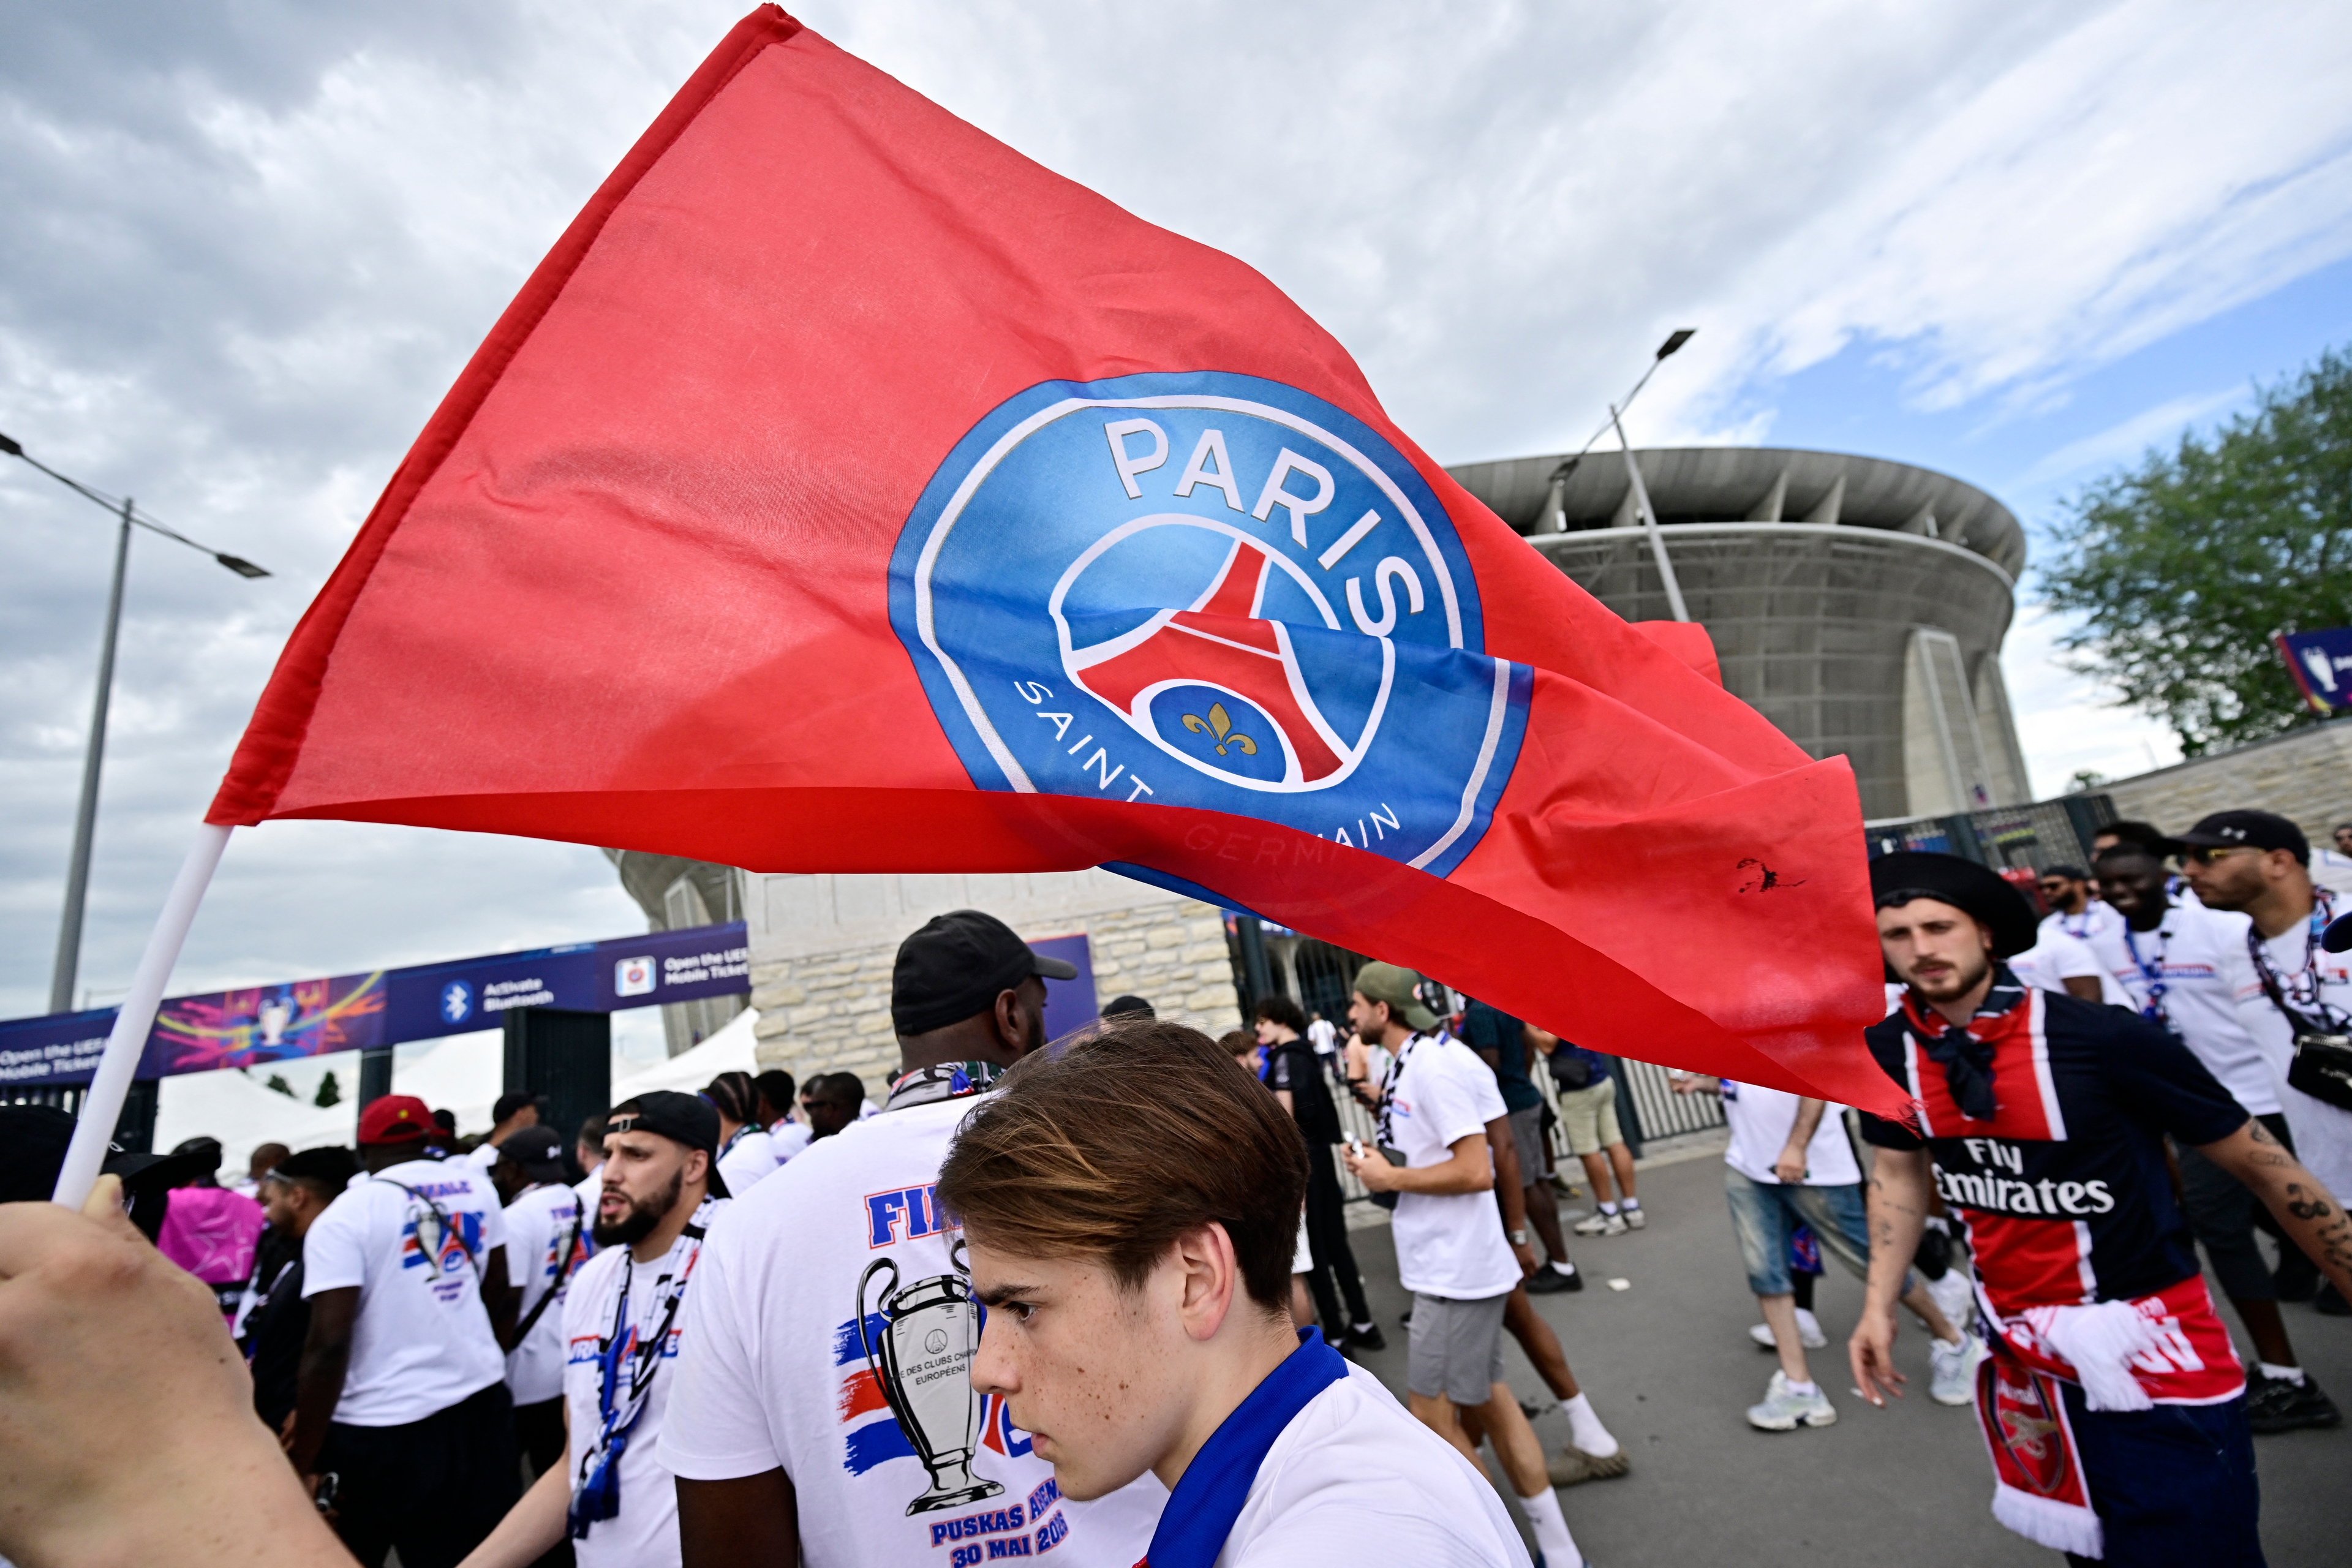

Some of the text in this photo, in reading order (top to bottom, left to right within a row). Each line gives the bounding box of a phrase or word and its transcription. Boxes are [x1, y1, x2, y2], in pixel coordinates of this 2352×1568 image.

[1103, 418, 1424, 637] PARIS
[1014, 681, 1153, 802] SAINT
[664, 948, 748, 973] Open the UEF
[483, 978, 543, 997] Activate
[665, 968, 709, 985] Mobile
[483, 990, 554, 1012] Bluetooth
[0, 1049, 43, 1066] Open
[43, 1044, 72, 1060] the
[1963, 1138, 2024, 1175] Fly
[1931, 1163, 2115, 1214] Emirates
[906, 1364, 922, 1376] DES
[924, 1355, 952, 1370] CLUBS
[916, 1364, 966, 1385] EUROPÉENS
[929, 1504, 1026, 1548] PUSKAS
[950, 1542, 983, 1568] 30
[985, 1534, 1033, 1561] MAI
